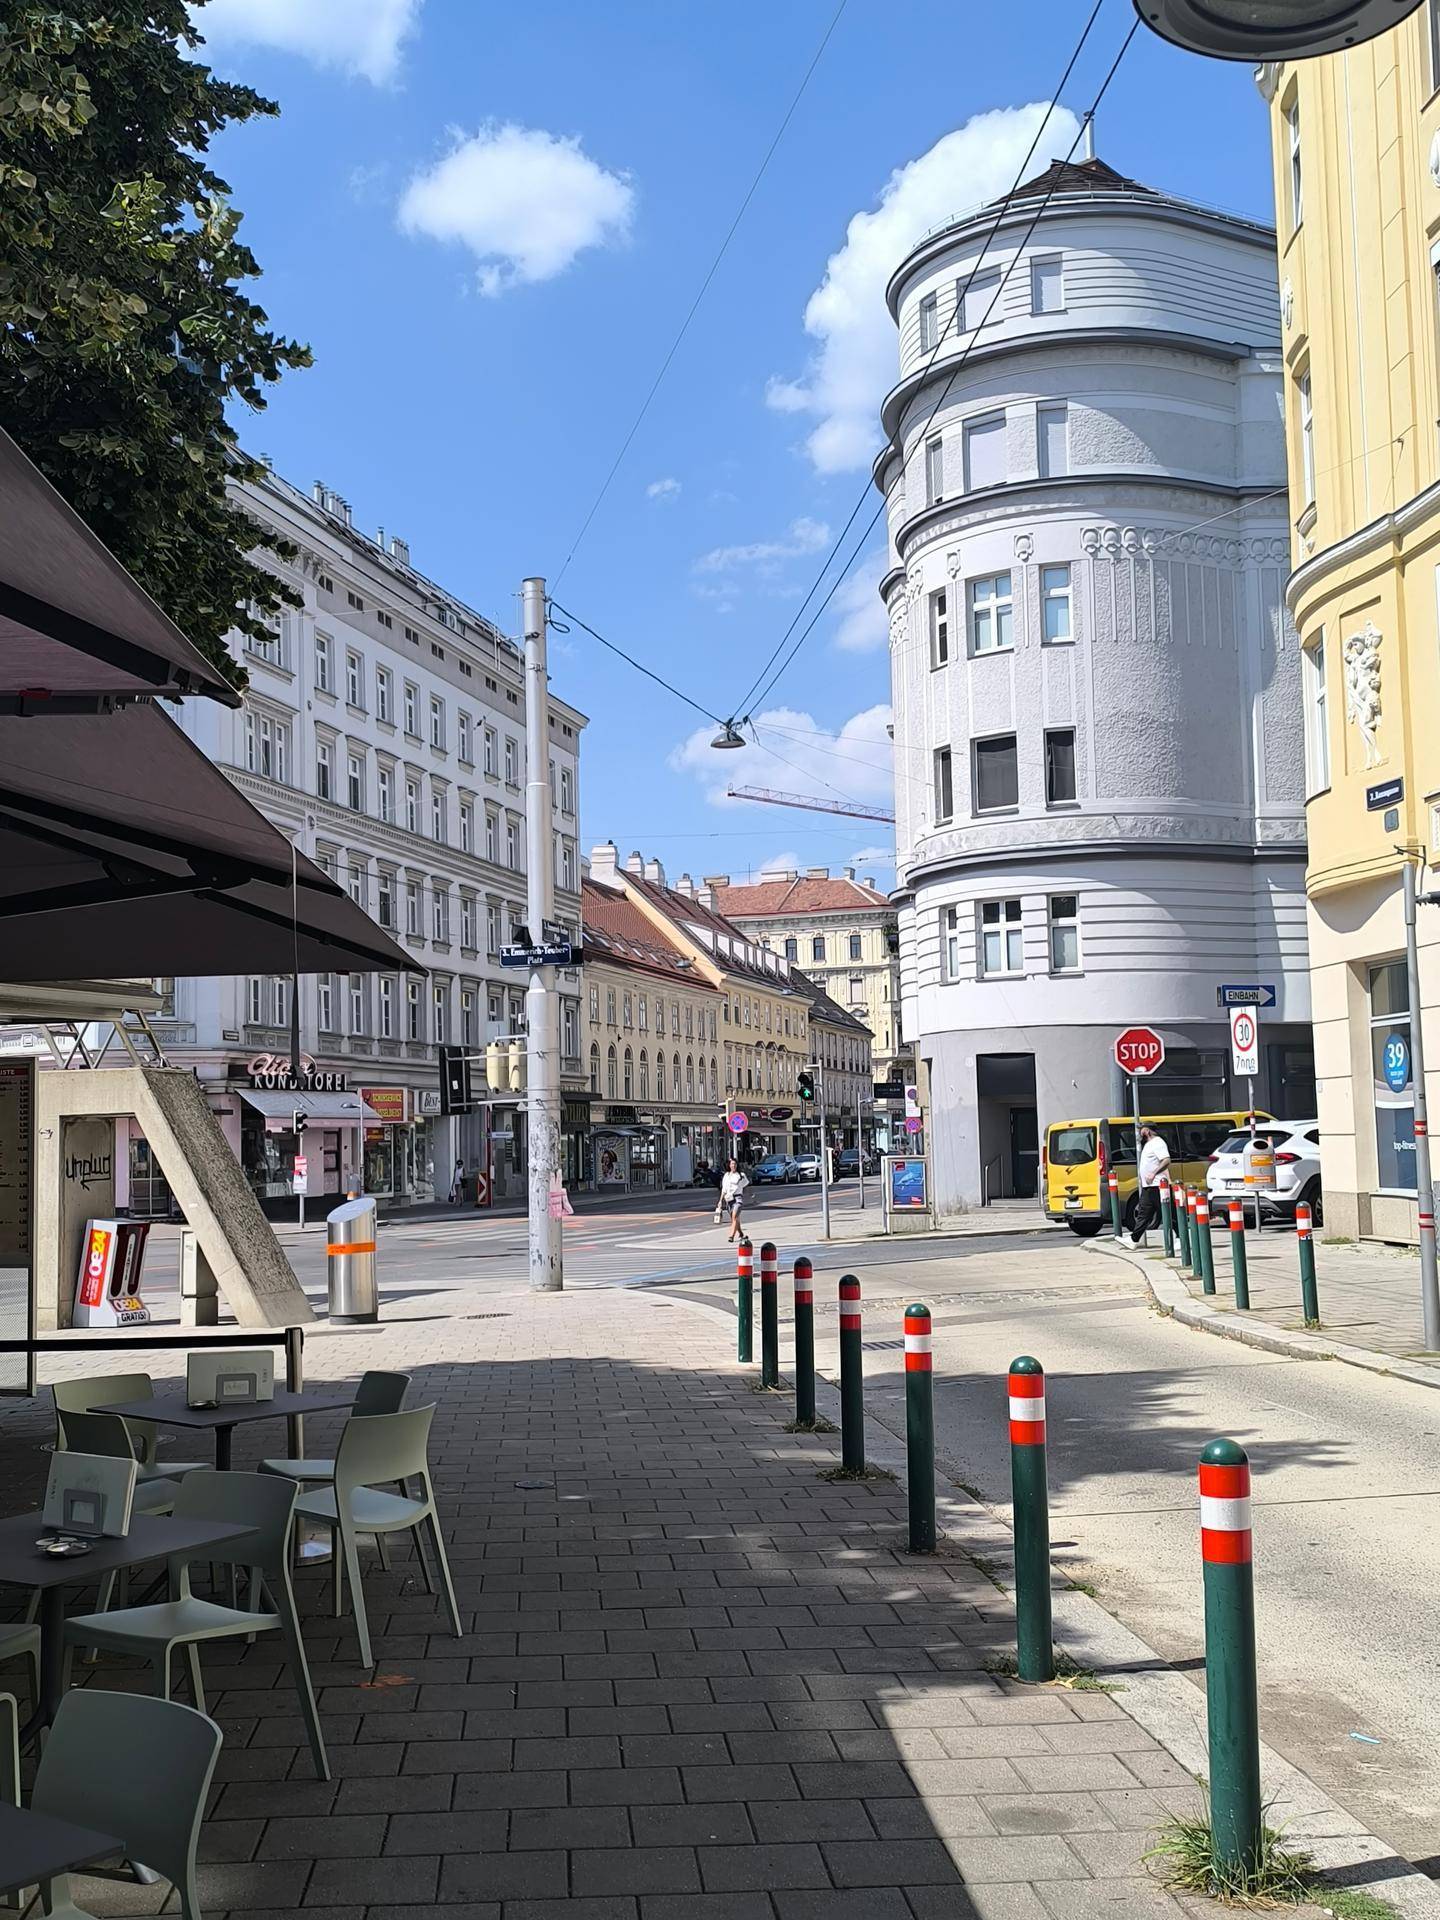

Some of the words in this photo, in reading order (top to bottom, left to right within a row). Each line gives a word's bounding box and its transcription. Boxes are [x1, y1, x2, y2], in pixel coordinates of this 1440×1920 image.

[1228, 990, 1259, 1001] EINBAHN
[1238, 1023, 1250, 1042] 30
[1120, 1042, 1159, 1061] STOP
[1387, 1042, 1405, 1068] 39
[254, 1073, 348, 1092] KONDTOREI
[121, 1311, 147, 1323] GRATIS!
